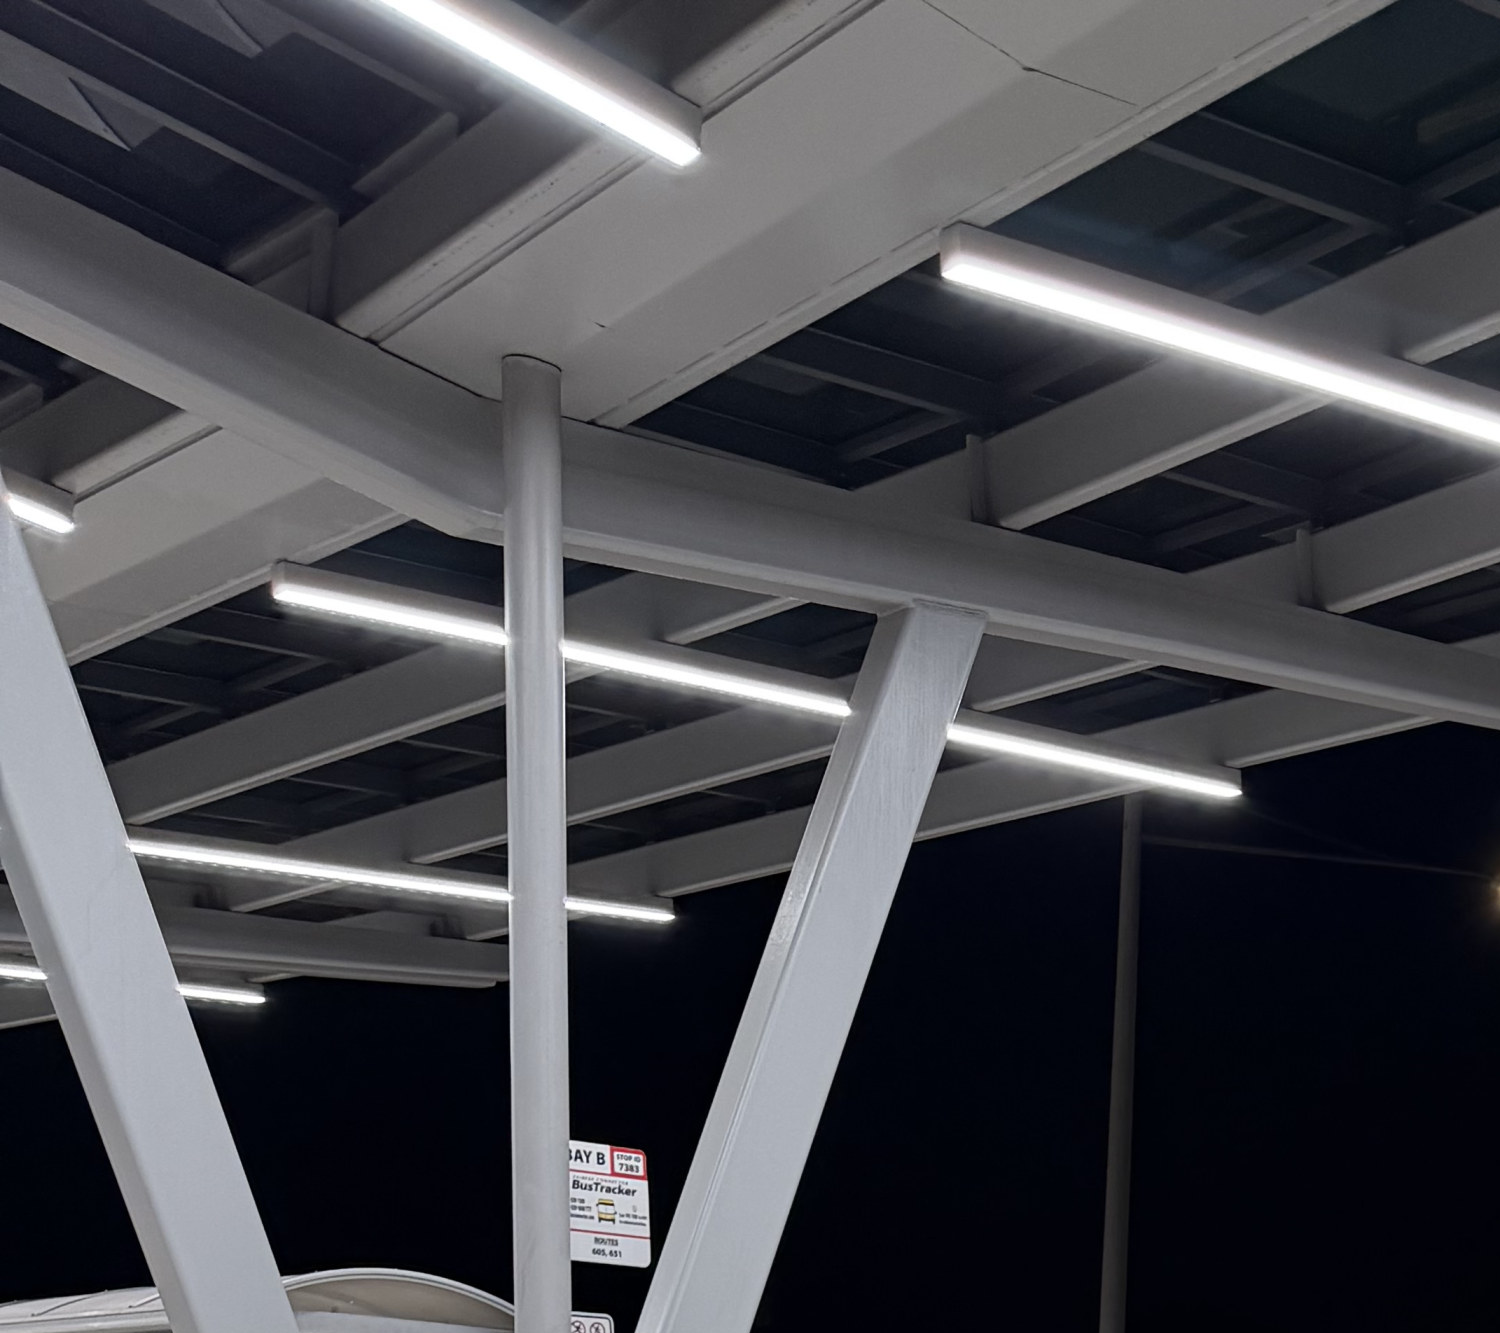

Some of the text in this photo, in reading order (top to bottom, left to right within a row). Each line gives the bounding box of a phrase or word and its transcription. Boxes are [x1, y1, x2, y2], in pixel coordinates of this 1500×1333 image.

[596, 1152, 606, 1165] B
[619, 1163, 640, 1173] 7383
[572, 1180, 637, 1197] BusTracker
